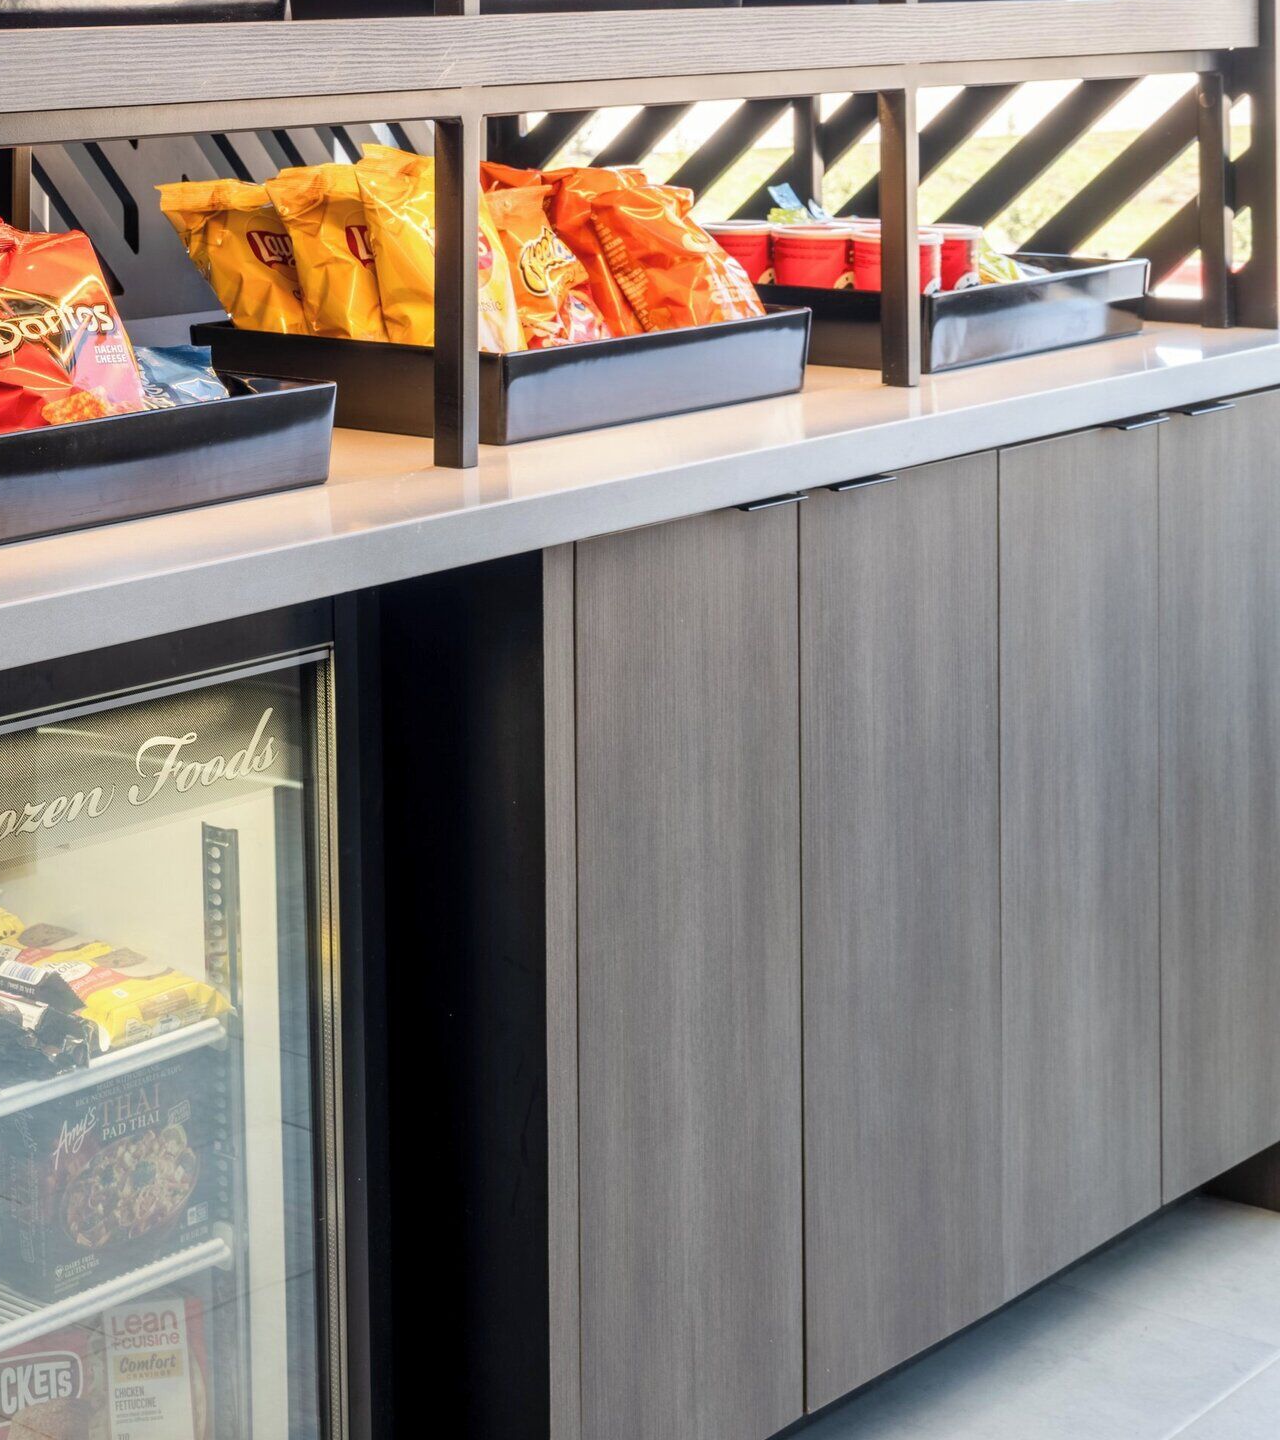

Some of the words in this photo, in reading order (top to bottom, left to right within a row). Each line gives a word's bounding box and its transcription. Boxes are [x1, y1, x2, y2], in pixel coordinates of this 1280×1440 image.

[94, 345, 124, 354] NACHO
[96, 353, 128, 364] CHEESE
[128, 707, 280, 806] Foods
[101, 1122, 127, 1141] PAD
[129, 1111, 160, 1133] THAI
[112, 1310, 178, 1336] Lean
[119, 1354, 176, 1374] Comfort
[115, 1386, 145, 1399] CHICKEN
[115, 1397, 157, 1411] FETTUCCINE
